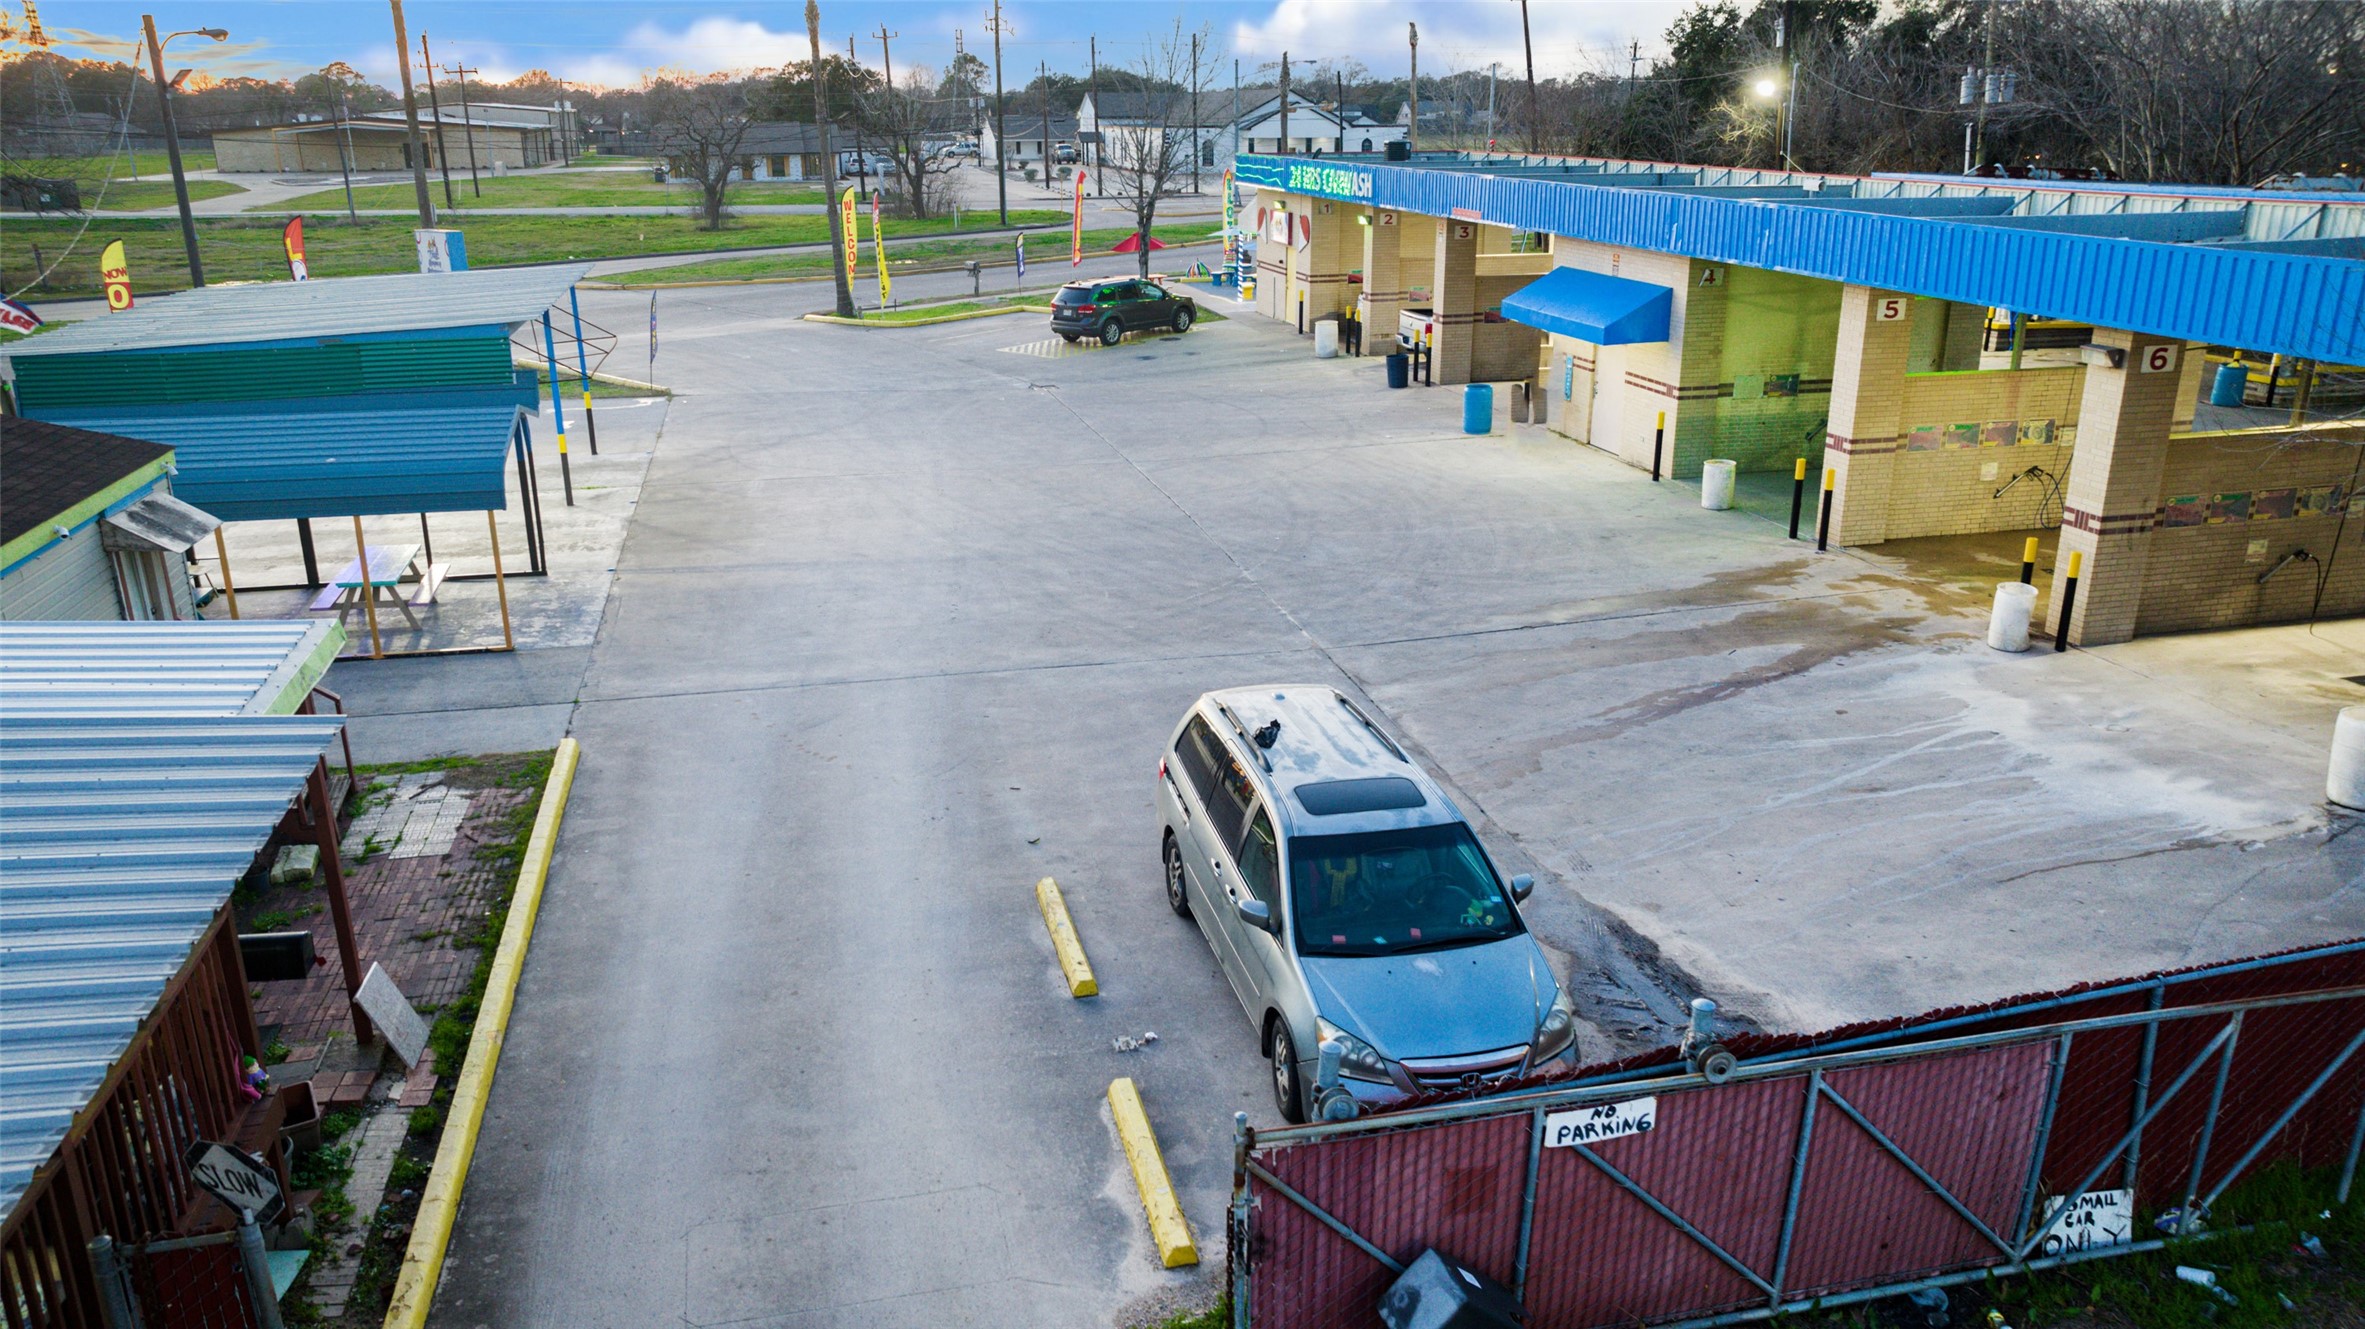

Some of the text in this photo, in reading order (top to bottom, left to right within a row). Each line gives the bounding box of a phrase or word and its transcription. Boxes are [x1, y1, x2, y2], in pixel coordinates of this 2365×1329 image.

[1323, 203, 1331, 214] 1
[1384, 214, 1393, 225] 2
[1459, 226, 1470, 239] 3
[104, 267, 128, 280] NOW
[1704, 269, 1716, 284] 4
[1884, 300, 1899, 318] 5
[2150, 347, 2169, 370] 6
[1590, 1105, 1617, 1120] NO
[199, 1163, 263, 1199] SLOW
[2065, 1211, 2095, 1228] CAR
